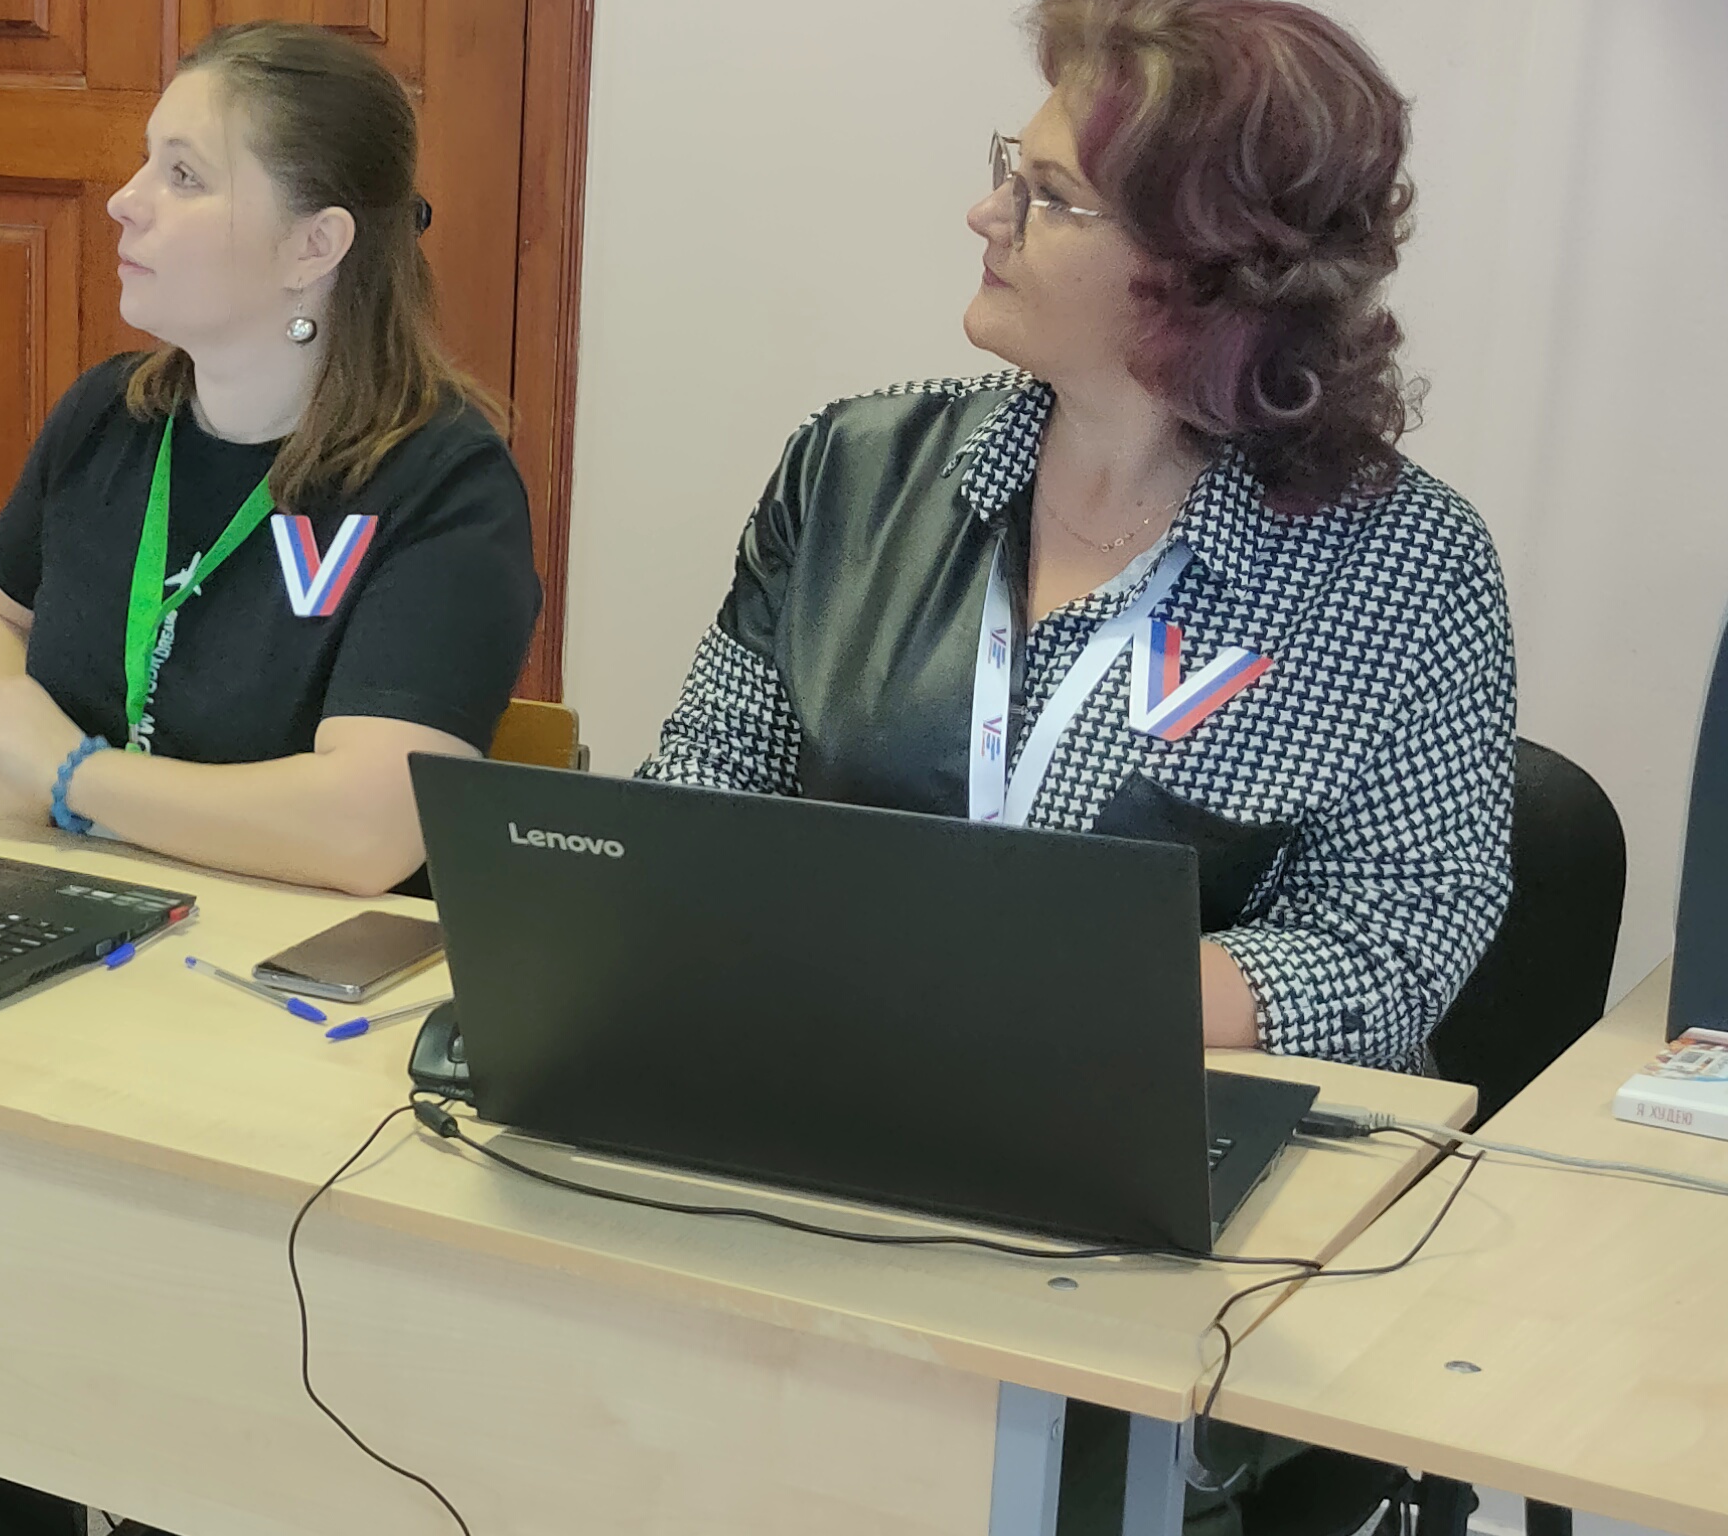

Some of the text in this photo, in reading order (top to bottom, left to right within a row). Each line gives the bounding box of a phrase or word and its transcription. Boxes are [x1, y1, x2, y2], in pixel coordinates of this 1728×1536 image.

[508, 822, 626, 859] Lenovo
[1636, 1102, 1693, 1126] Я ХУДЕЮ
